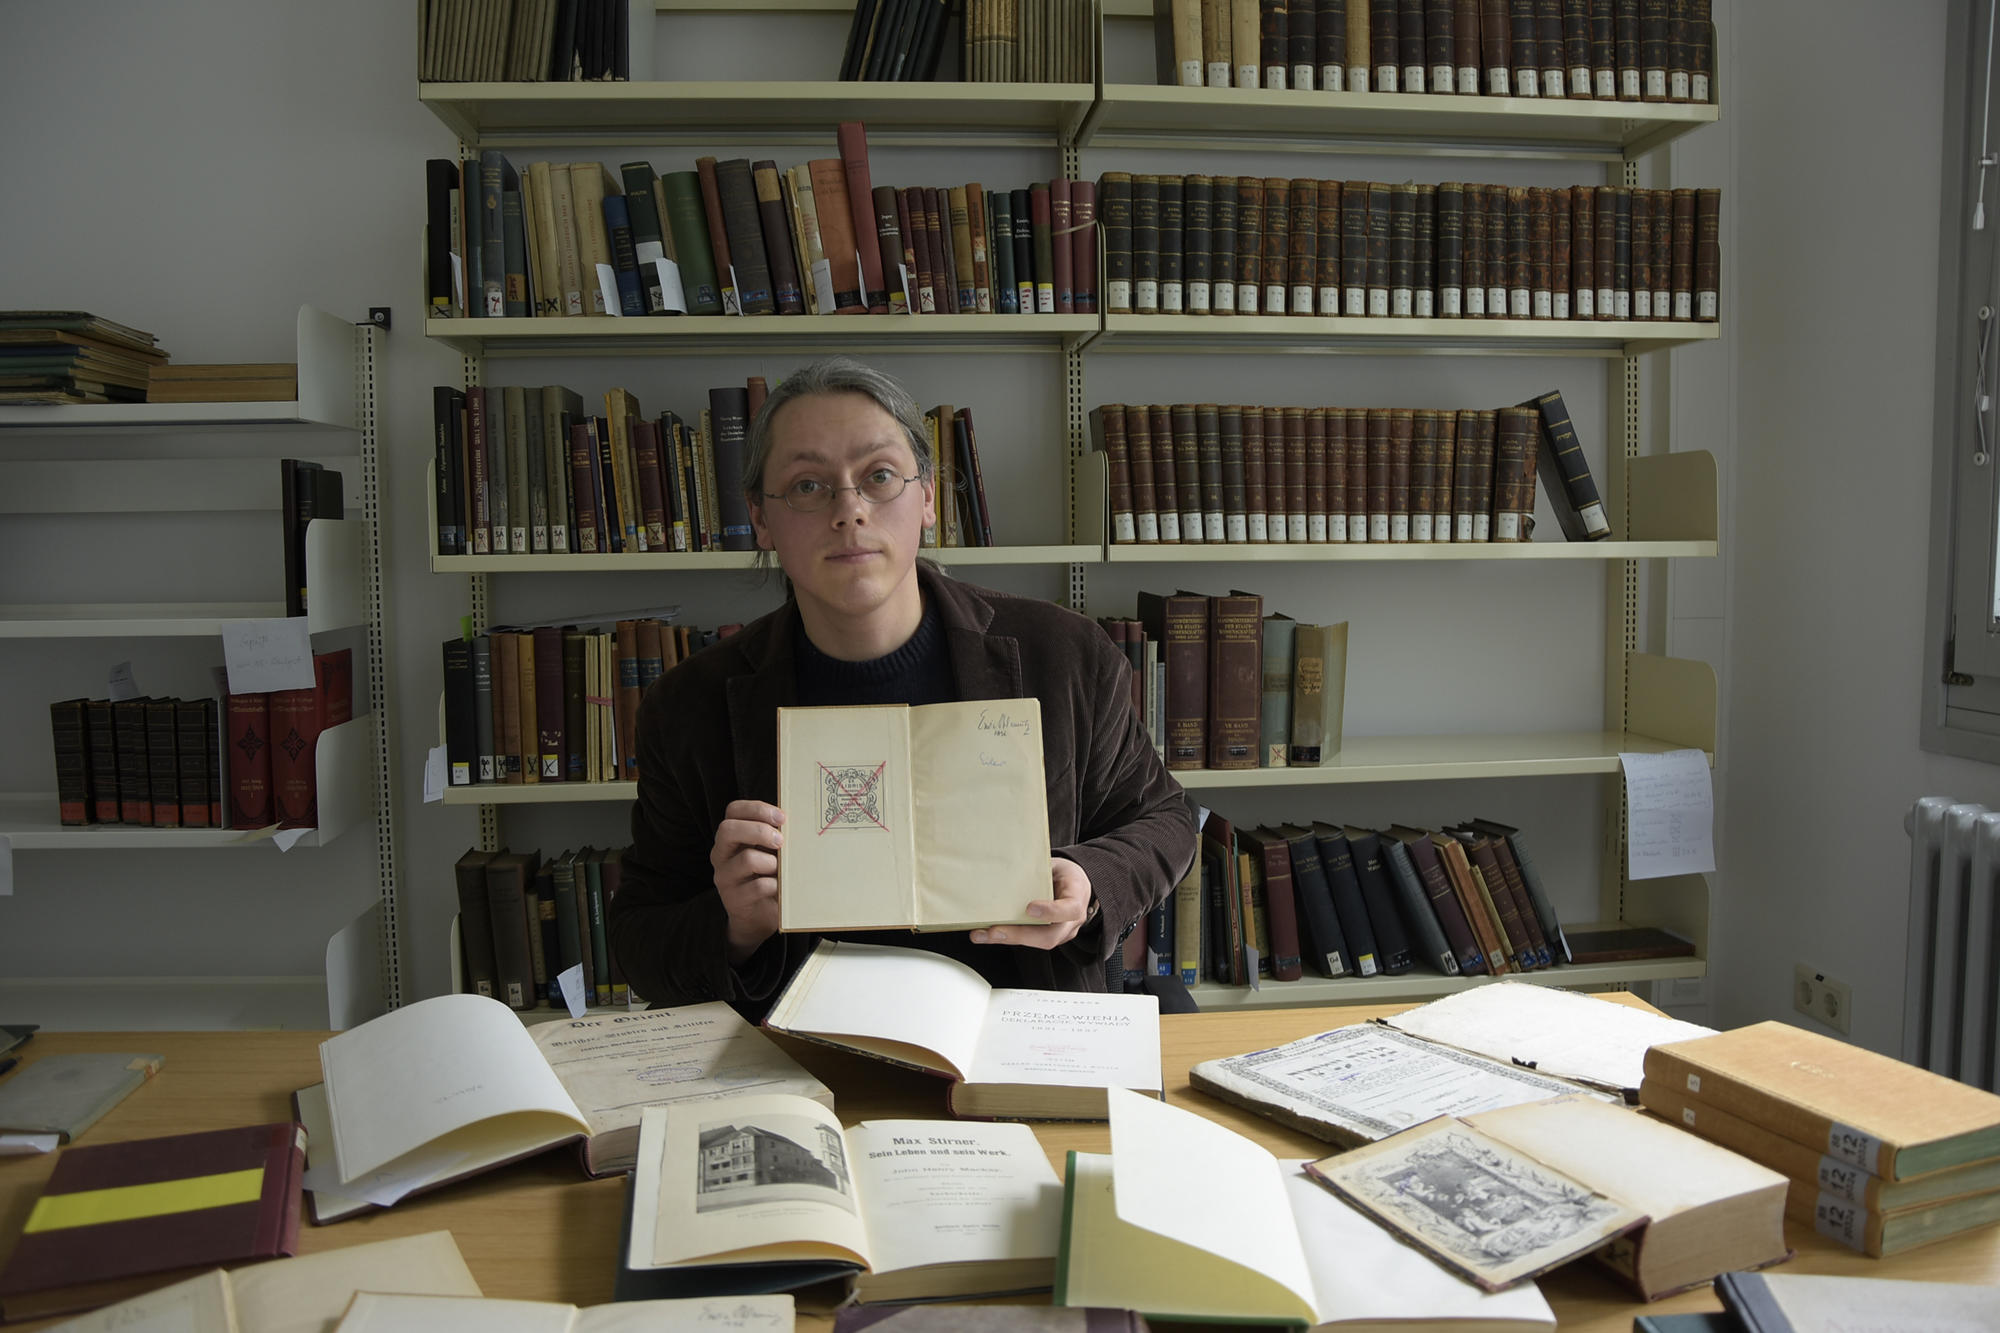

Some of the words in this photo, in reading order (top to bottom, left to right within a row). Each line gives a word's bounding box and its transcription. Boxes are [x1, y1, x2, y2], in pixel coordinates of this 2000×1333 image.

[569, 1020, 603, 1028] Der
[893, 1137, 921, 1145] Max
[928, 1137, 981, 1146] Stirner.
[1842, 1133, 1858, 1156] 12
[869, 1150, 893, 1159] Sein
[895, 1148, 927, 1156] Leben
[978, 1149, 1012, 1157] Werk.
[1831, 1167, 1847, 1191] 12
[1828, 1205, 1845, 1228] 12
